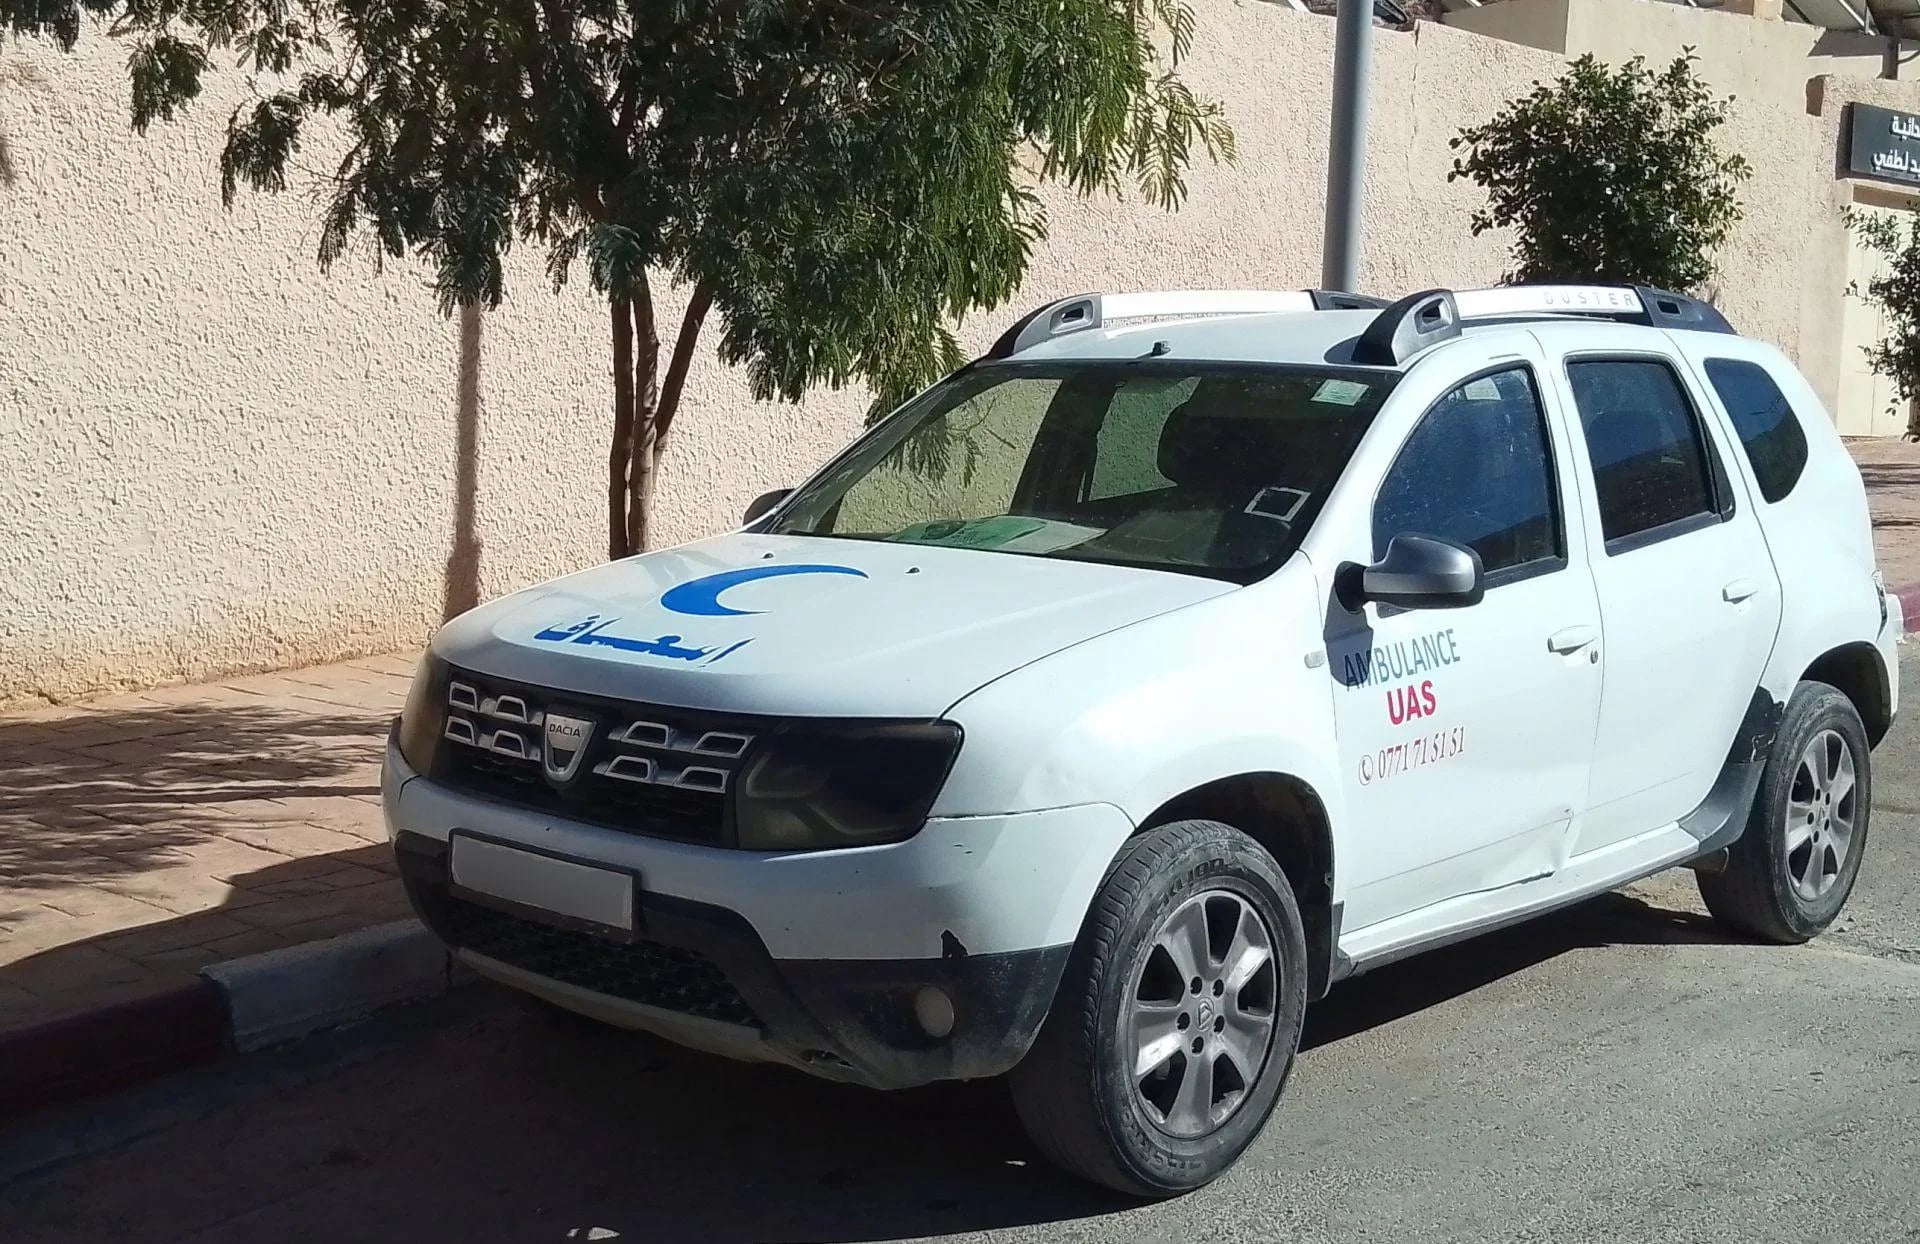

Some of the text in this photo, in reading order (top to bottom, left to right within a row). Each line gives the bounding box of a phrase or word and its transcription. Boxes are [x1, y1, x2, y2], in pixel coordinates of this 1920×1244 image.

[1873, 148, 1909, 171] لطفي
[1543, 291, 1634, 306] DUSTER
[1344, 628, 1461, 692] AMBULANCE
[1386, 680, 1437, 725] UAS
[548, 723, 581, 738] DACIA
